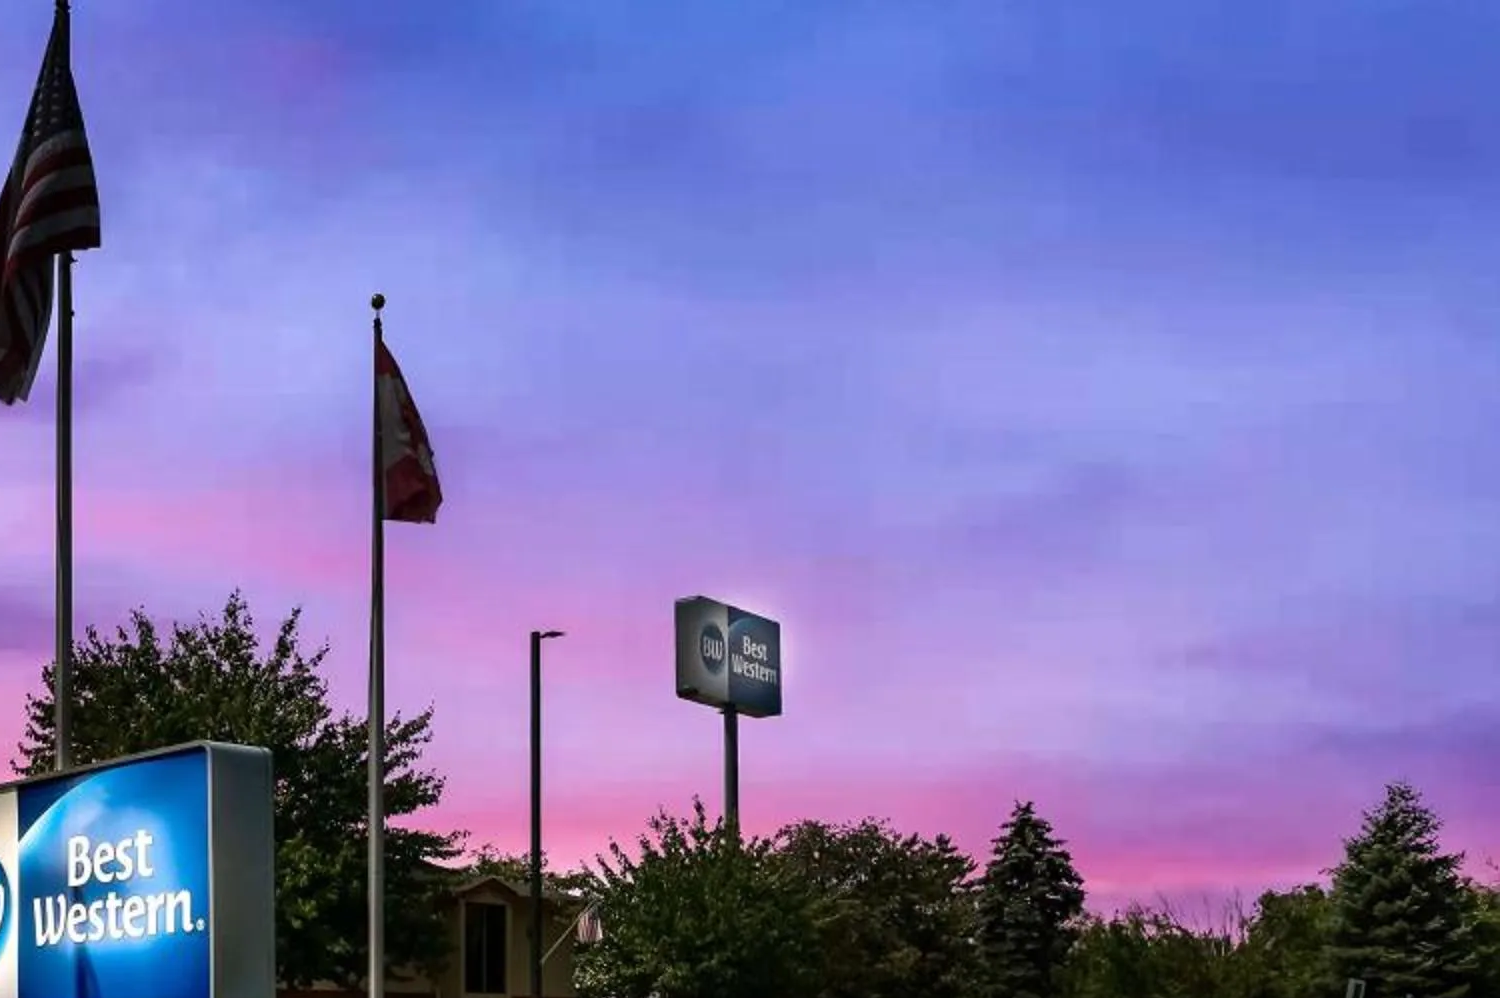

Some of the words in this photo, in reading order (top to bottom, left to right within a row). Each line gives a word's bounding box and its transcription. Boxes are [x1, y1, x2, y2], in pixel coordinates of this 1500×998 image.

[703, 636, 723, 660] BW
[743, 635, 768, 661] Best
[731, 653, 777, 684] Western
[67, 829, 153, 887] Best
[33, 889, 195, 947] Western
